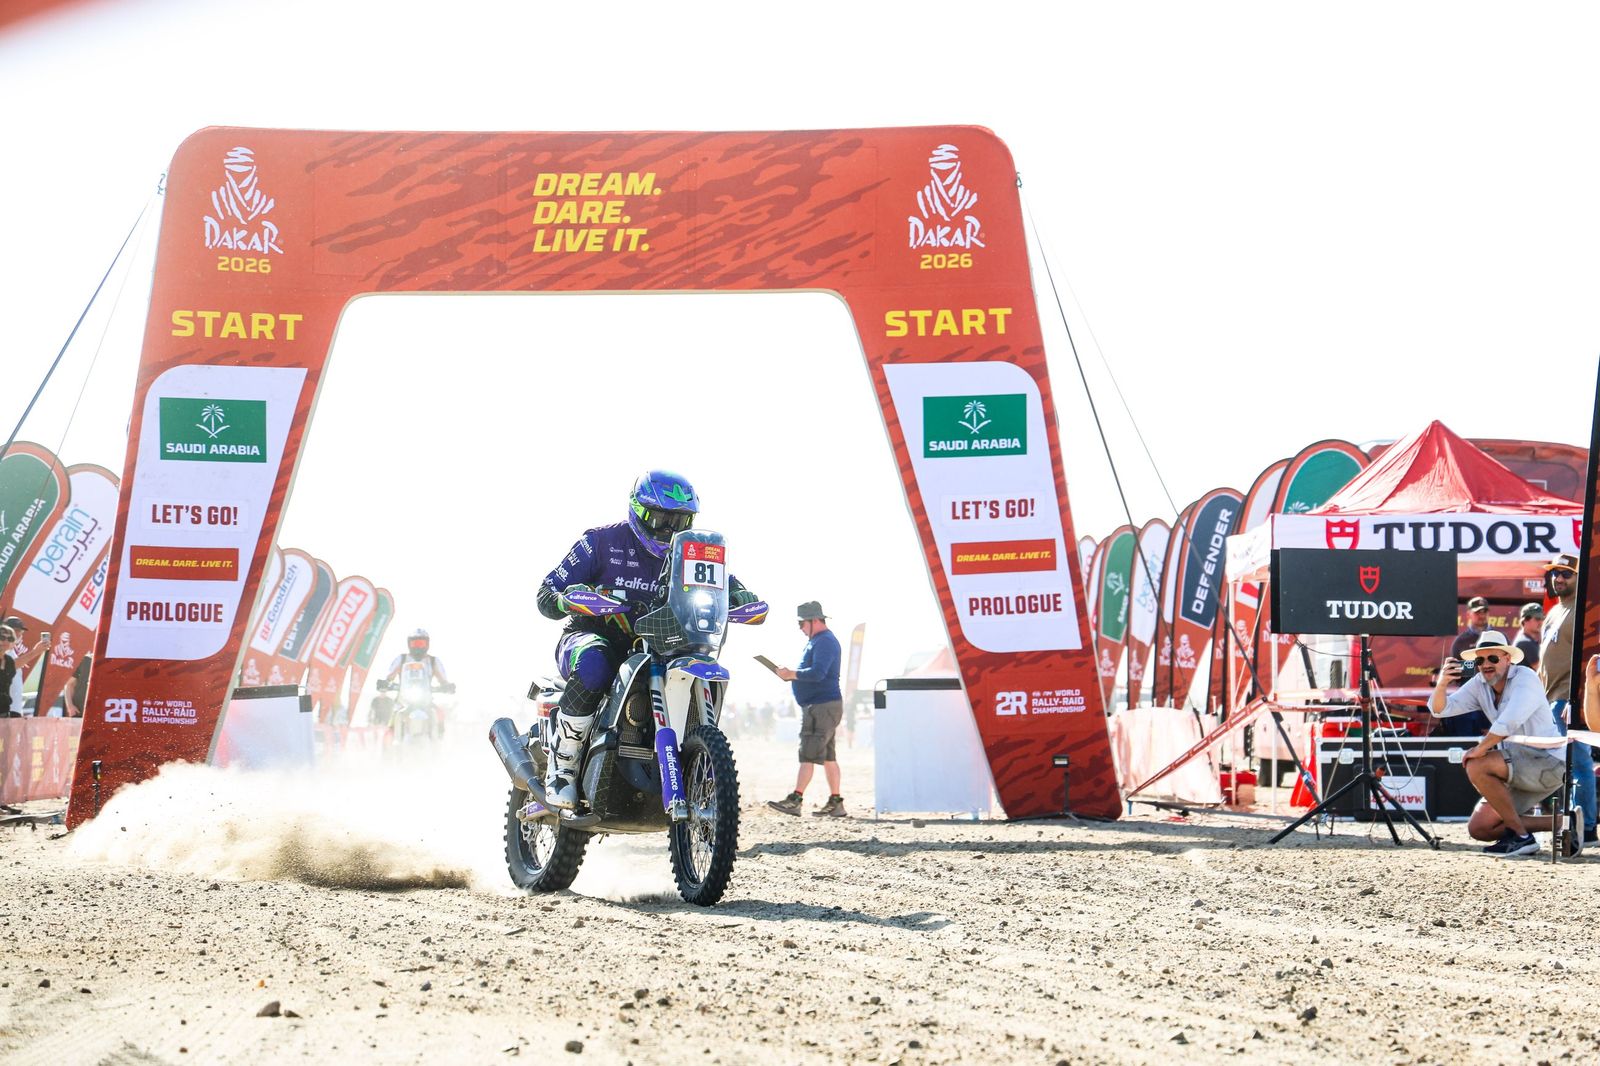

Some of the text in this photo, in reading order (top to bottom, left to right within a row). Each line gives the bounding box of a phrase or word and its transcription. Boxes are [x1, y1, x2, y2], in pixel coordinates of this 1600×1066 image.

[533, 172, 662, 196] DREAM.
[533, 200, 631, 225] DARE.
[203, 215, 284, 254] DAKAR
[533, 228, 650, 253] LIVE IT.
[908, 215, 985, 249] DAKAR
[217, 256, 272, 273] 2026
[920, 253, 973, 270] 2026
[171, 310, 304, 341] START
[885, 307, 1013, 337] START
[166, 443, 260, 456] SAUDI ARABIA
[929, 438, 1021, 451] SAUDI ARABIA
[207, 506, 238, 526] GO!
[1005, 498, 1035, 518] GO!
[11, 498, 46, 543] ARABIA
[31, 508, 90, 576] berain
[1373, 521, 1561, 554] TUDOR
[135, 558, 171, 567] DREAM.
[200, 560, 221, 568] LIVE
[956, 550, 1052, 563] DREAM. DARE. LIVE IT.
[1191, 508, 1233, 615] DEFENDER
[694, 562, 717, 586] 81
[126, 601, 223, 622] PROLOGUE
[260, 564, 298, 641] BFGoodrich
[969, 593, 1062, 616] PROLOGUE
[1326, 600, 1414, 620] TUDOR
[321, 586, 366, 659] MOTUL
[166, 700, 193, 708] WORLD
[1031, 696, 1084, 707] RALLY-RAID
[1055, 689, 1081, 697] WORLD
[142, 706, 197, 717] RALLY-RAID
[142, 716, 198, 725] CHAMPIONSHIP
[1032, 705, 1087, 715] CHAMPIONSHIP
[664, 745, 679, 791] #alfafence
